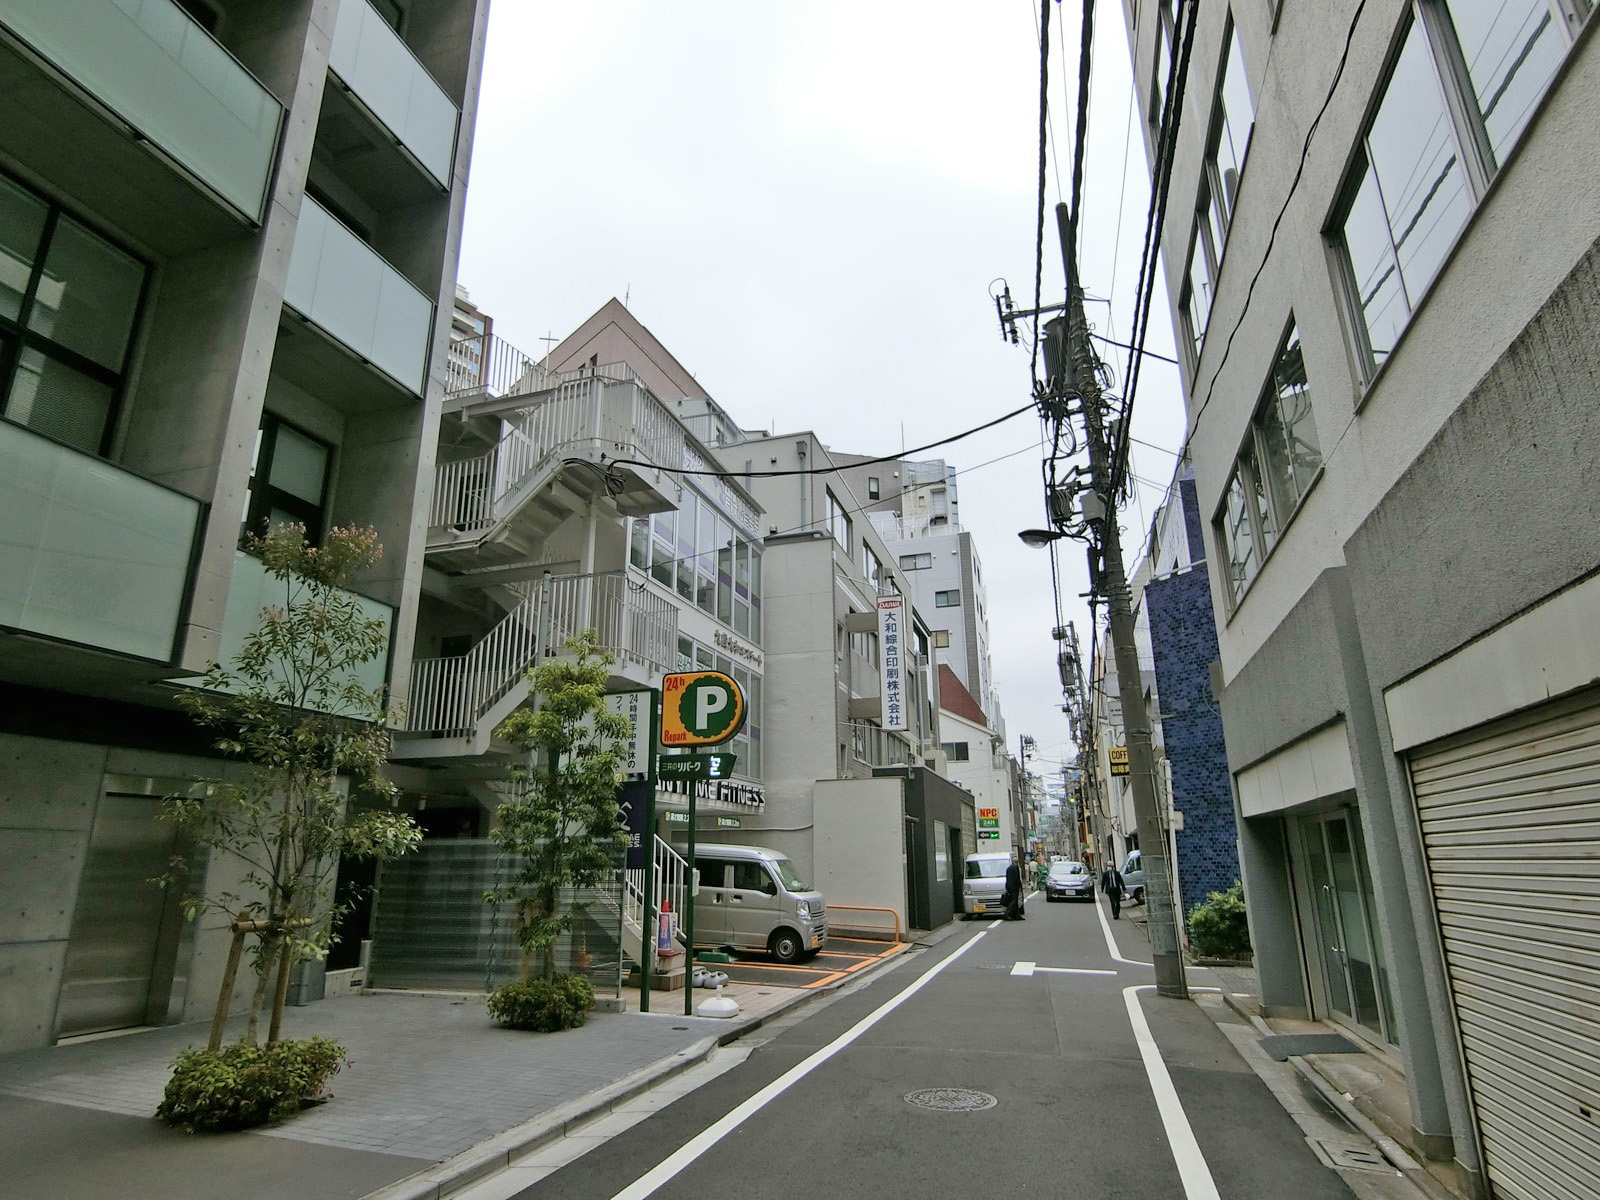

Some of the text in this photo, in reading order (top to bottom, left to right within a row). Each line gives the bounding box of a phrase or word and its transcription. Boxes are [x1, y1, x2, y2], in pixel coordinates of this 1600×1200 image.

[884, 611, 901, 726] 大和綜合印刷株式会社
[696, 686, 728, 730] P
[664, 730, 688, 742] Repark
[662, 761, 701, 772] 三井のリパーク
[720, 781, 766, 807] FITNESS
[979, 808, 997, 817] NPC
